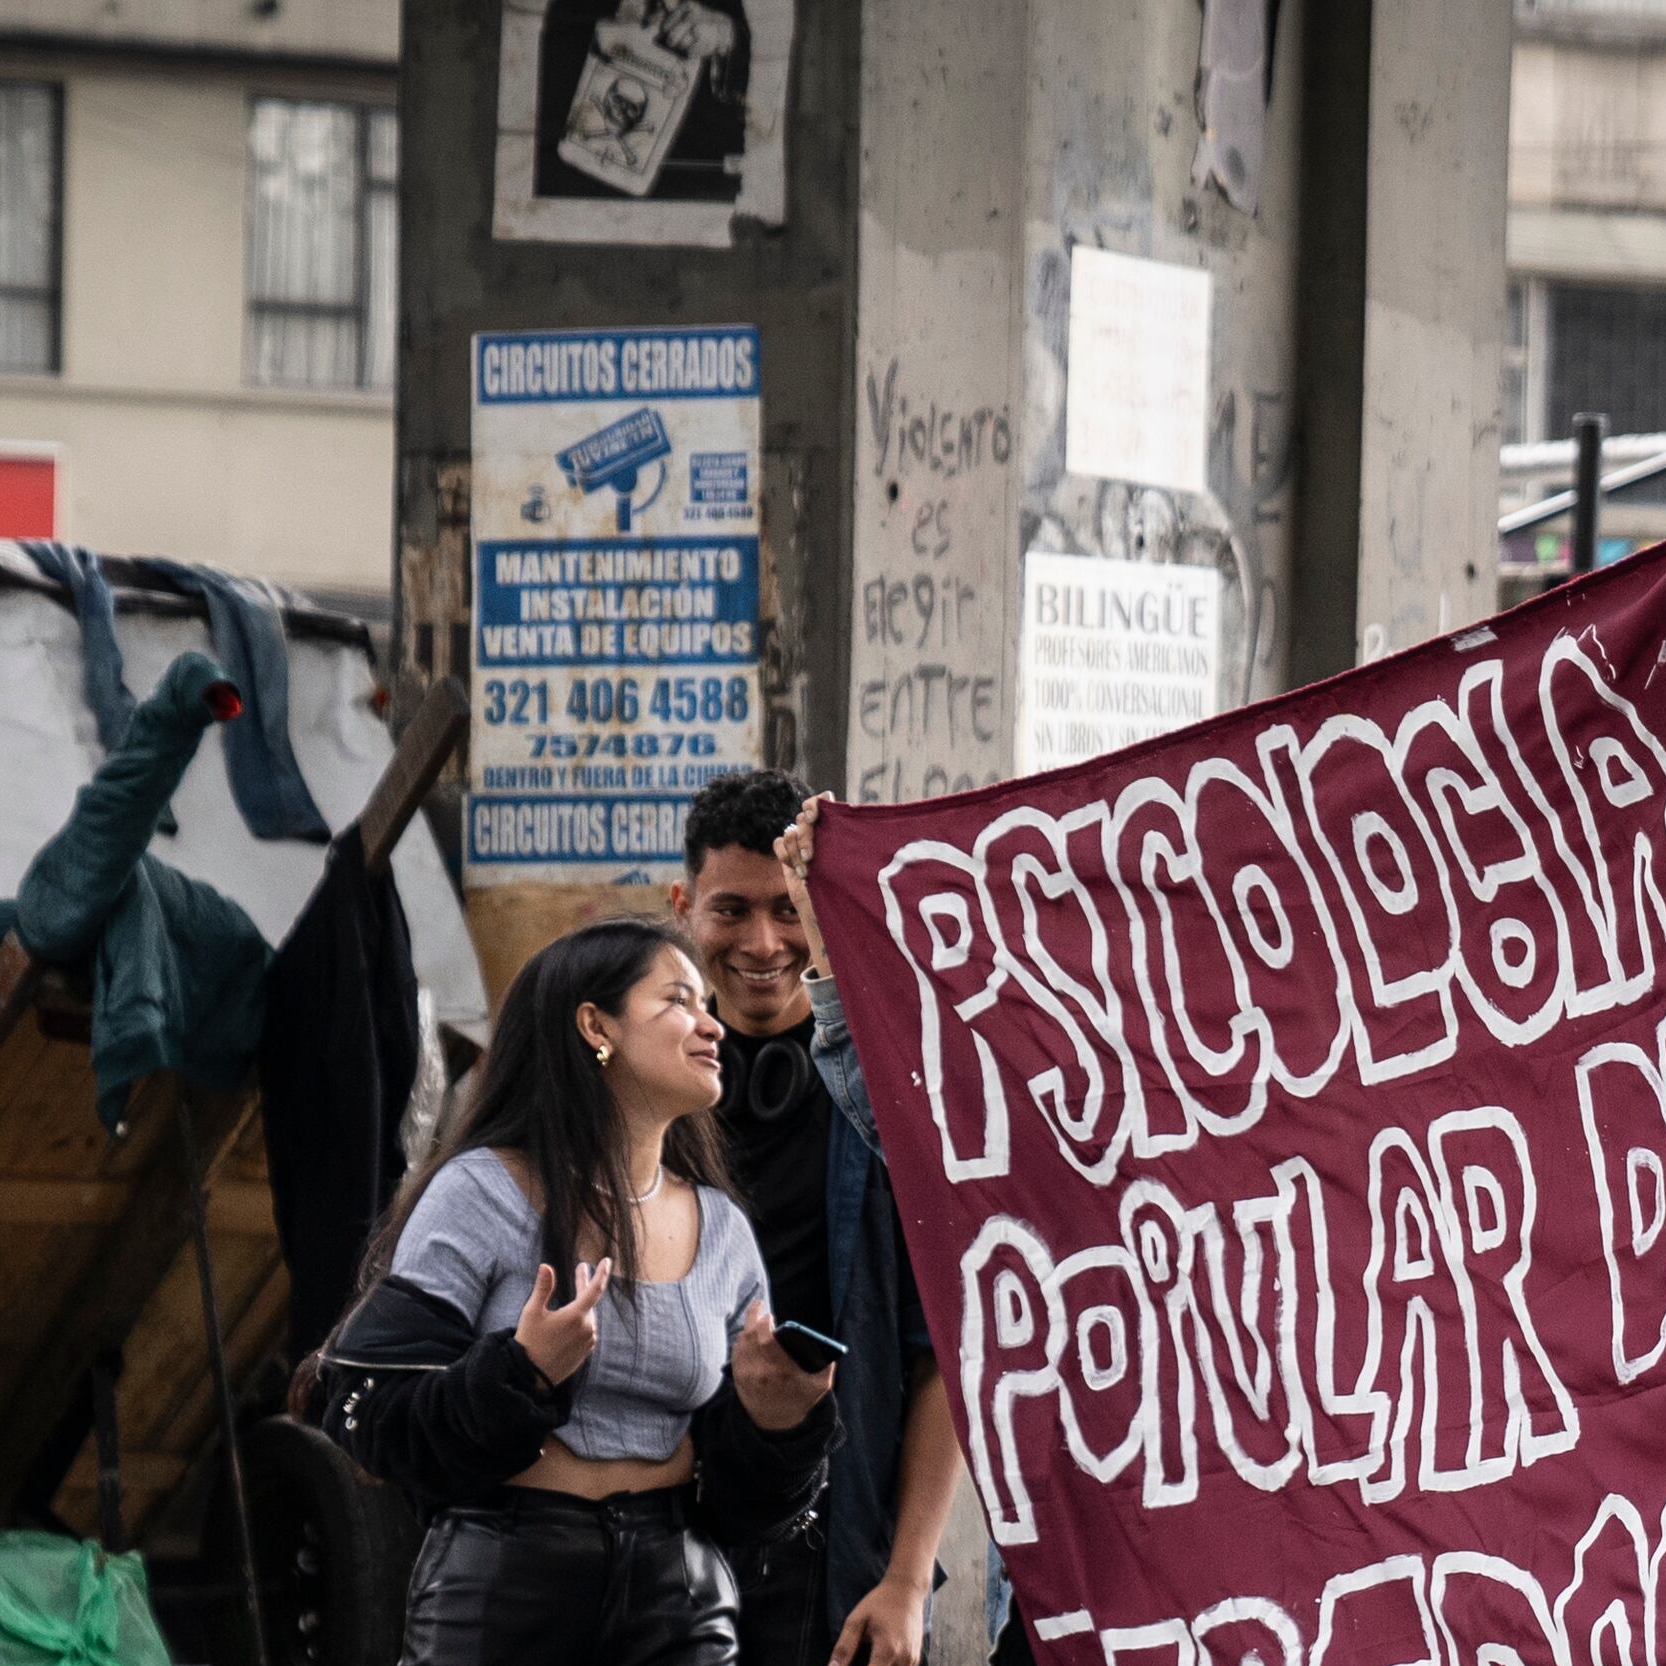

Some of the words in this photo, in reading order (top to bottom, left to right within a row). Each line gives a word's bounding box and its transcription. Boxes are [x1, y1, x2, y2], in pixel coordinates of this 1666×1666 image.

[483, 341, 616, 397] CIRCUITOS
[621, 336, 753, 391] CERRADOS
[495, 547, 741, 584] MANTENIMIENTO
[519, 583, 716, 622] INSTALACIÓN
[1036, 580, 1208, 640] BILINGÜE
[483, 624, 574, 660] VENTA
[580, 624, 616, 655] DE
[623, 620, 753, 659] EQUIPOS
[1035, 634, 1121, 671] PROFESORES
[1127, 641, 1209, 678] AMERICANOS
[485, 679, 548, 726] 321
[566, 678, 639, 724] 406
[649, 675, 749, 724] 4588
[1086, 681, 1203, 718] CONVERSACIONAL
[525, 732, 717, 759] 7574876
[484, 766, 552, 788] DENTRO
[556, 768, 567, 787] Y
[573, 767, 627, 788] FUERA
[633, 766, 654, 787] DE
[659, 766, 679, 786] LA
[475, 803, 606, 855] CIRCUITOS
[960, 1105, 1581, 1546] POPULAR
